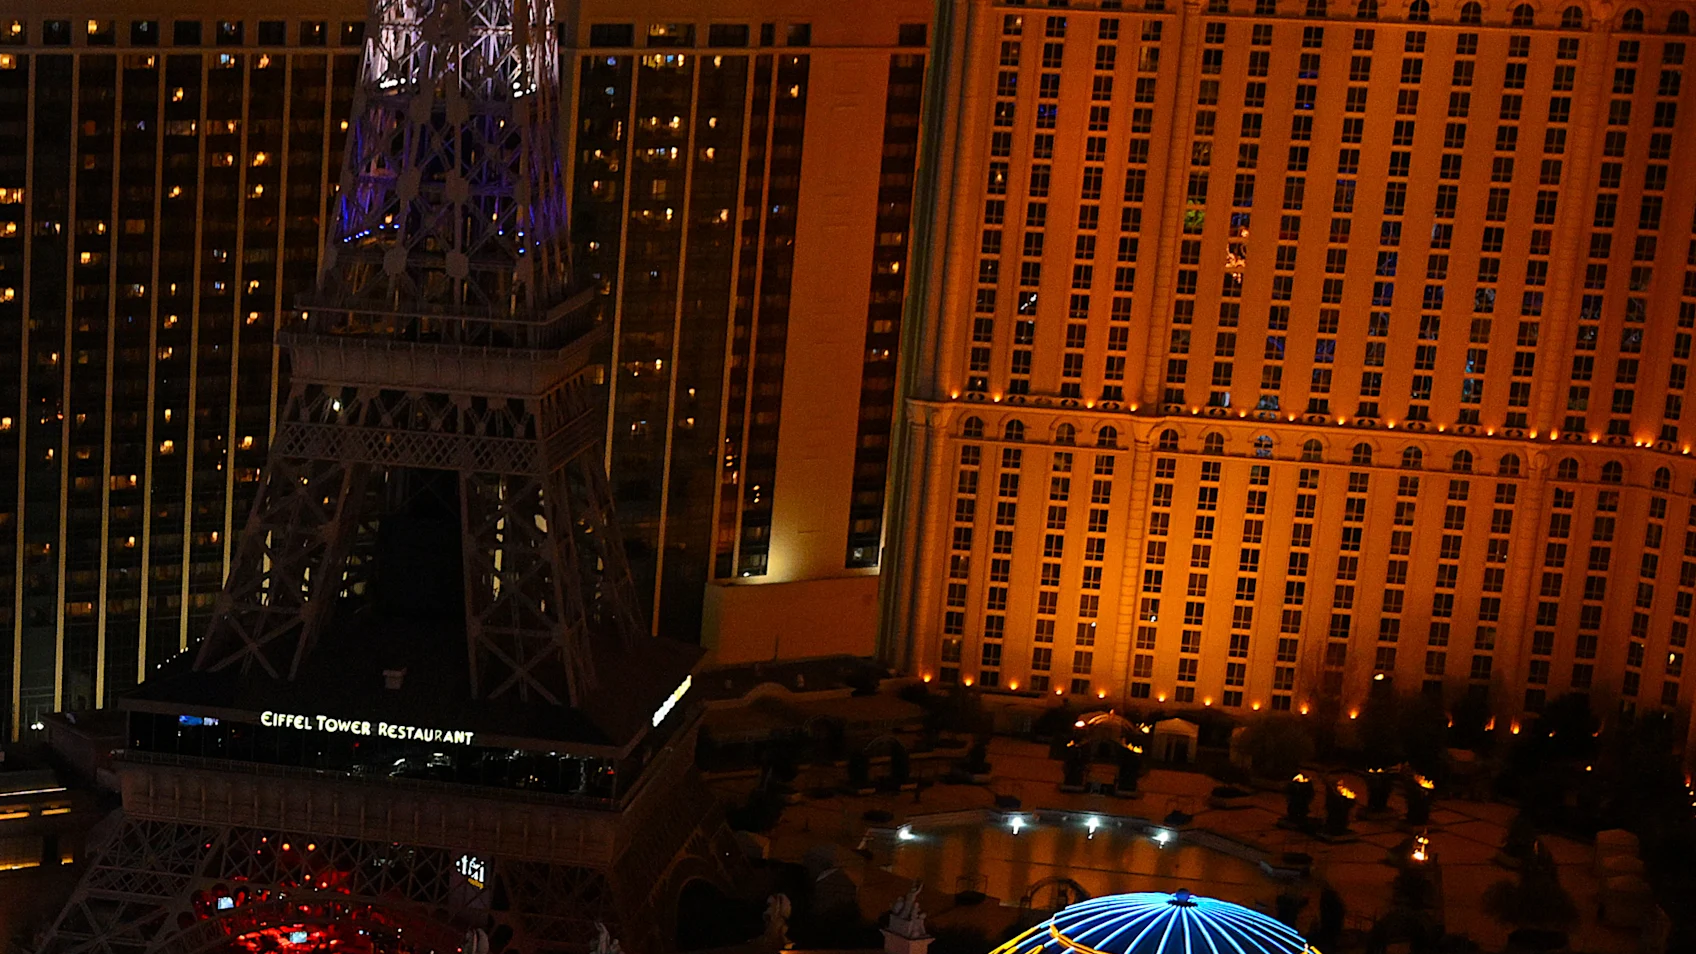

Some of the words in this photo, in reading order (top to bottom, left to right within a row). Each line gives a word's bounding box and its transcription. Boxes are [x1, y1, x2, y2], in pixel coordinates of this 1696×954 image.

[260, 711, 312, 730] EIFFEL
[316, 715, 370, 735] TOWER
[378, 722, 474, 745] RESTAURANT
